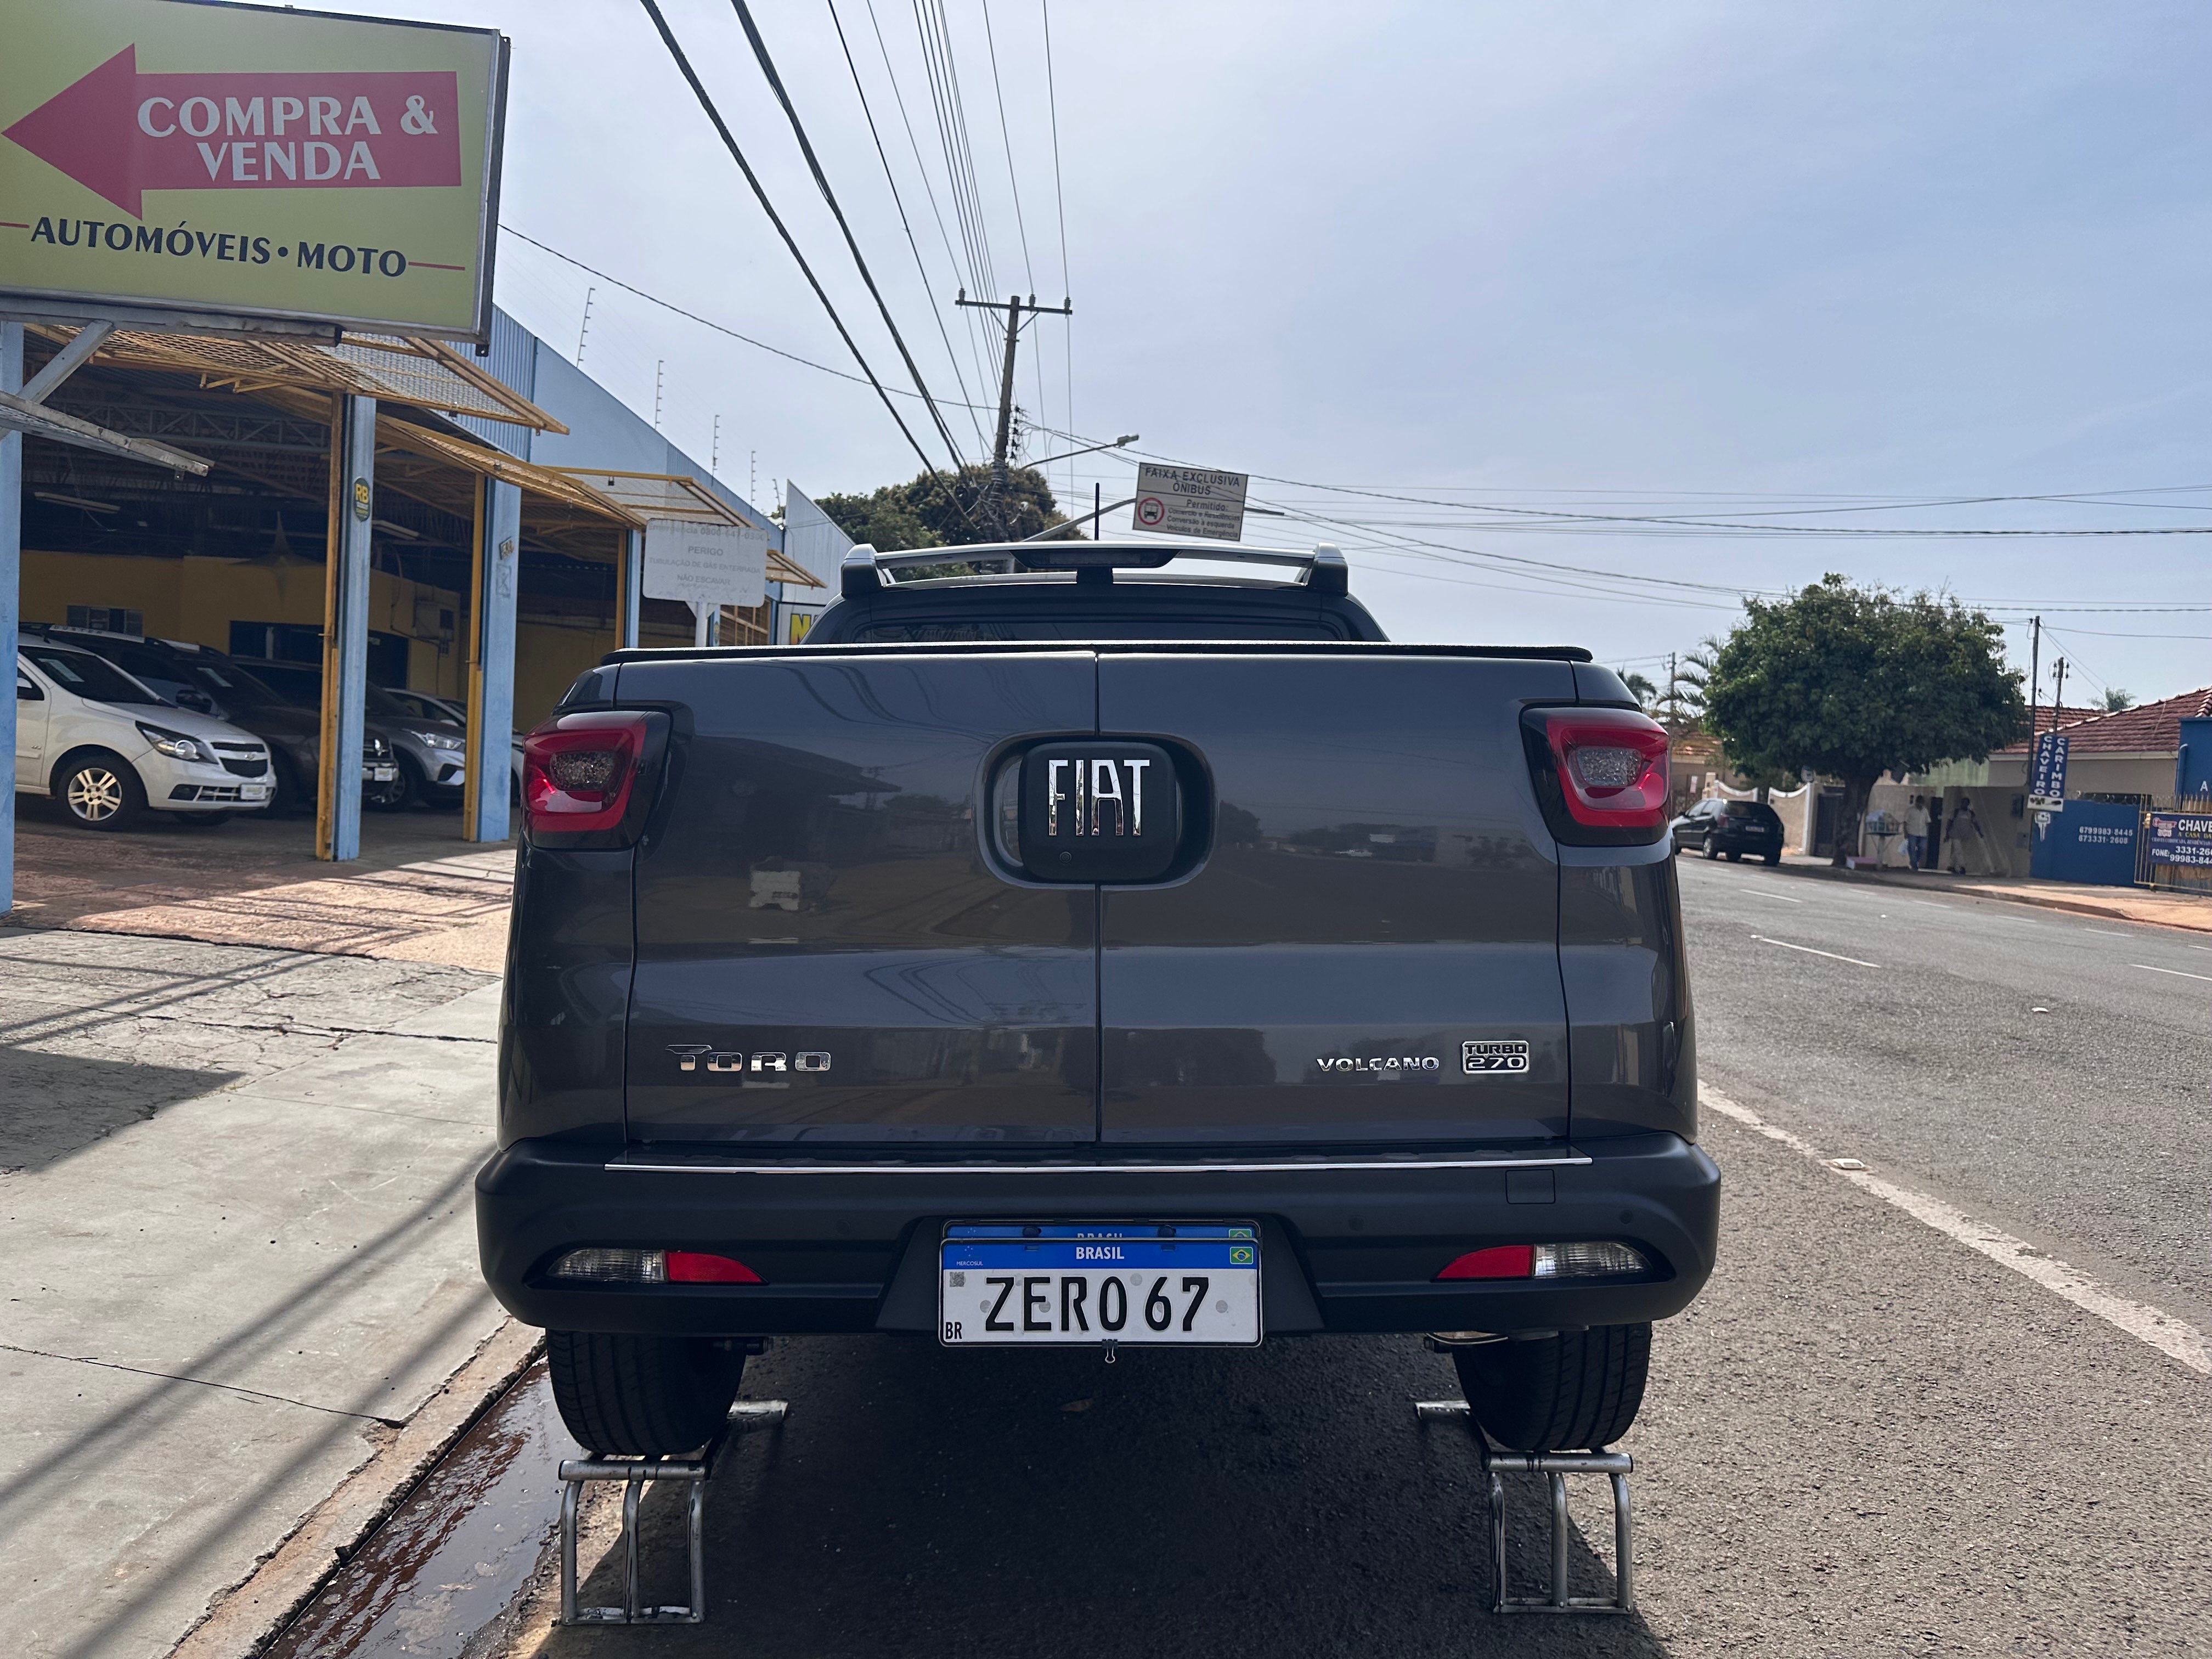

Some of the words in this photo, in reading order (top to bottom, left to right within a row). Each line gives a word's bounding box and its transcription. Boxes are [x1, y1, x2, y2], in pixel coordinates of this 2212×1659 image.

[138, 96, 382, 138] COMPRA
[400, 94, 438, 136] &
[196, 140, 381, 182] VENDA
[30, 217, 270, 264] AUTOMÓVEIS
[297, 241, 407, 277] MOTO
[1145, 467, 1177, 480] FAIXA
[1182, 471, 1240, 487] EXCLUSIVA
[356, 483, 369, 504] RB
[1172, 481, 1211, 495] ÔNIBUS
[1187, 499, 1229, 511] Permitido:
[1167, 516, 1199, 525] Conversão
[1206, 521, 1235, 529] esquerda
[687, 546, 724, 556] PERIGO
[649, 557, 690, 567] TUBULAÇÃO
[703, 561, 717, 569] GÁS
[719, 564, 760, 573] ENTERRADA
[678, 574, 693, 582] NÃO
[695, 576, 731, 585] ESCAVAR
[2034, 736, 2052, 795] CHAVEIRO
[2049, 738, 2066, 798] CARIMBO
[1048, 759, 1150, 836] FIAT
[2152, 849, 2170, 857] FONE:
[1464, 1045, 1528, 1054] TURBO
[665, 1045, 832, 1071] TORO
[1316, 1057, 1440, 1072] VOLCANO
[1468, 1058, 1525, 1069] 270
[1076, 1246, 1125, 1260] BRASIL
[1144, 1277, 1209, 1331] 67
[945, 1322, 962, 1339] BR
